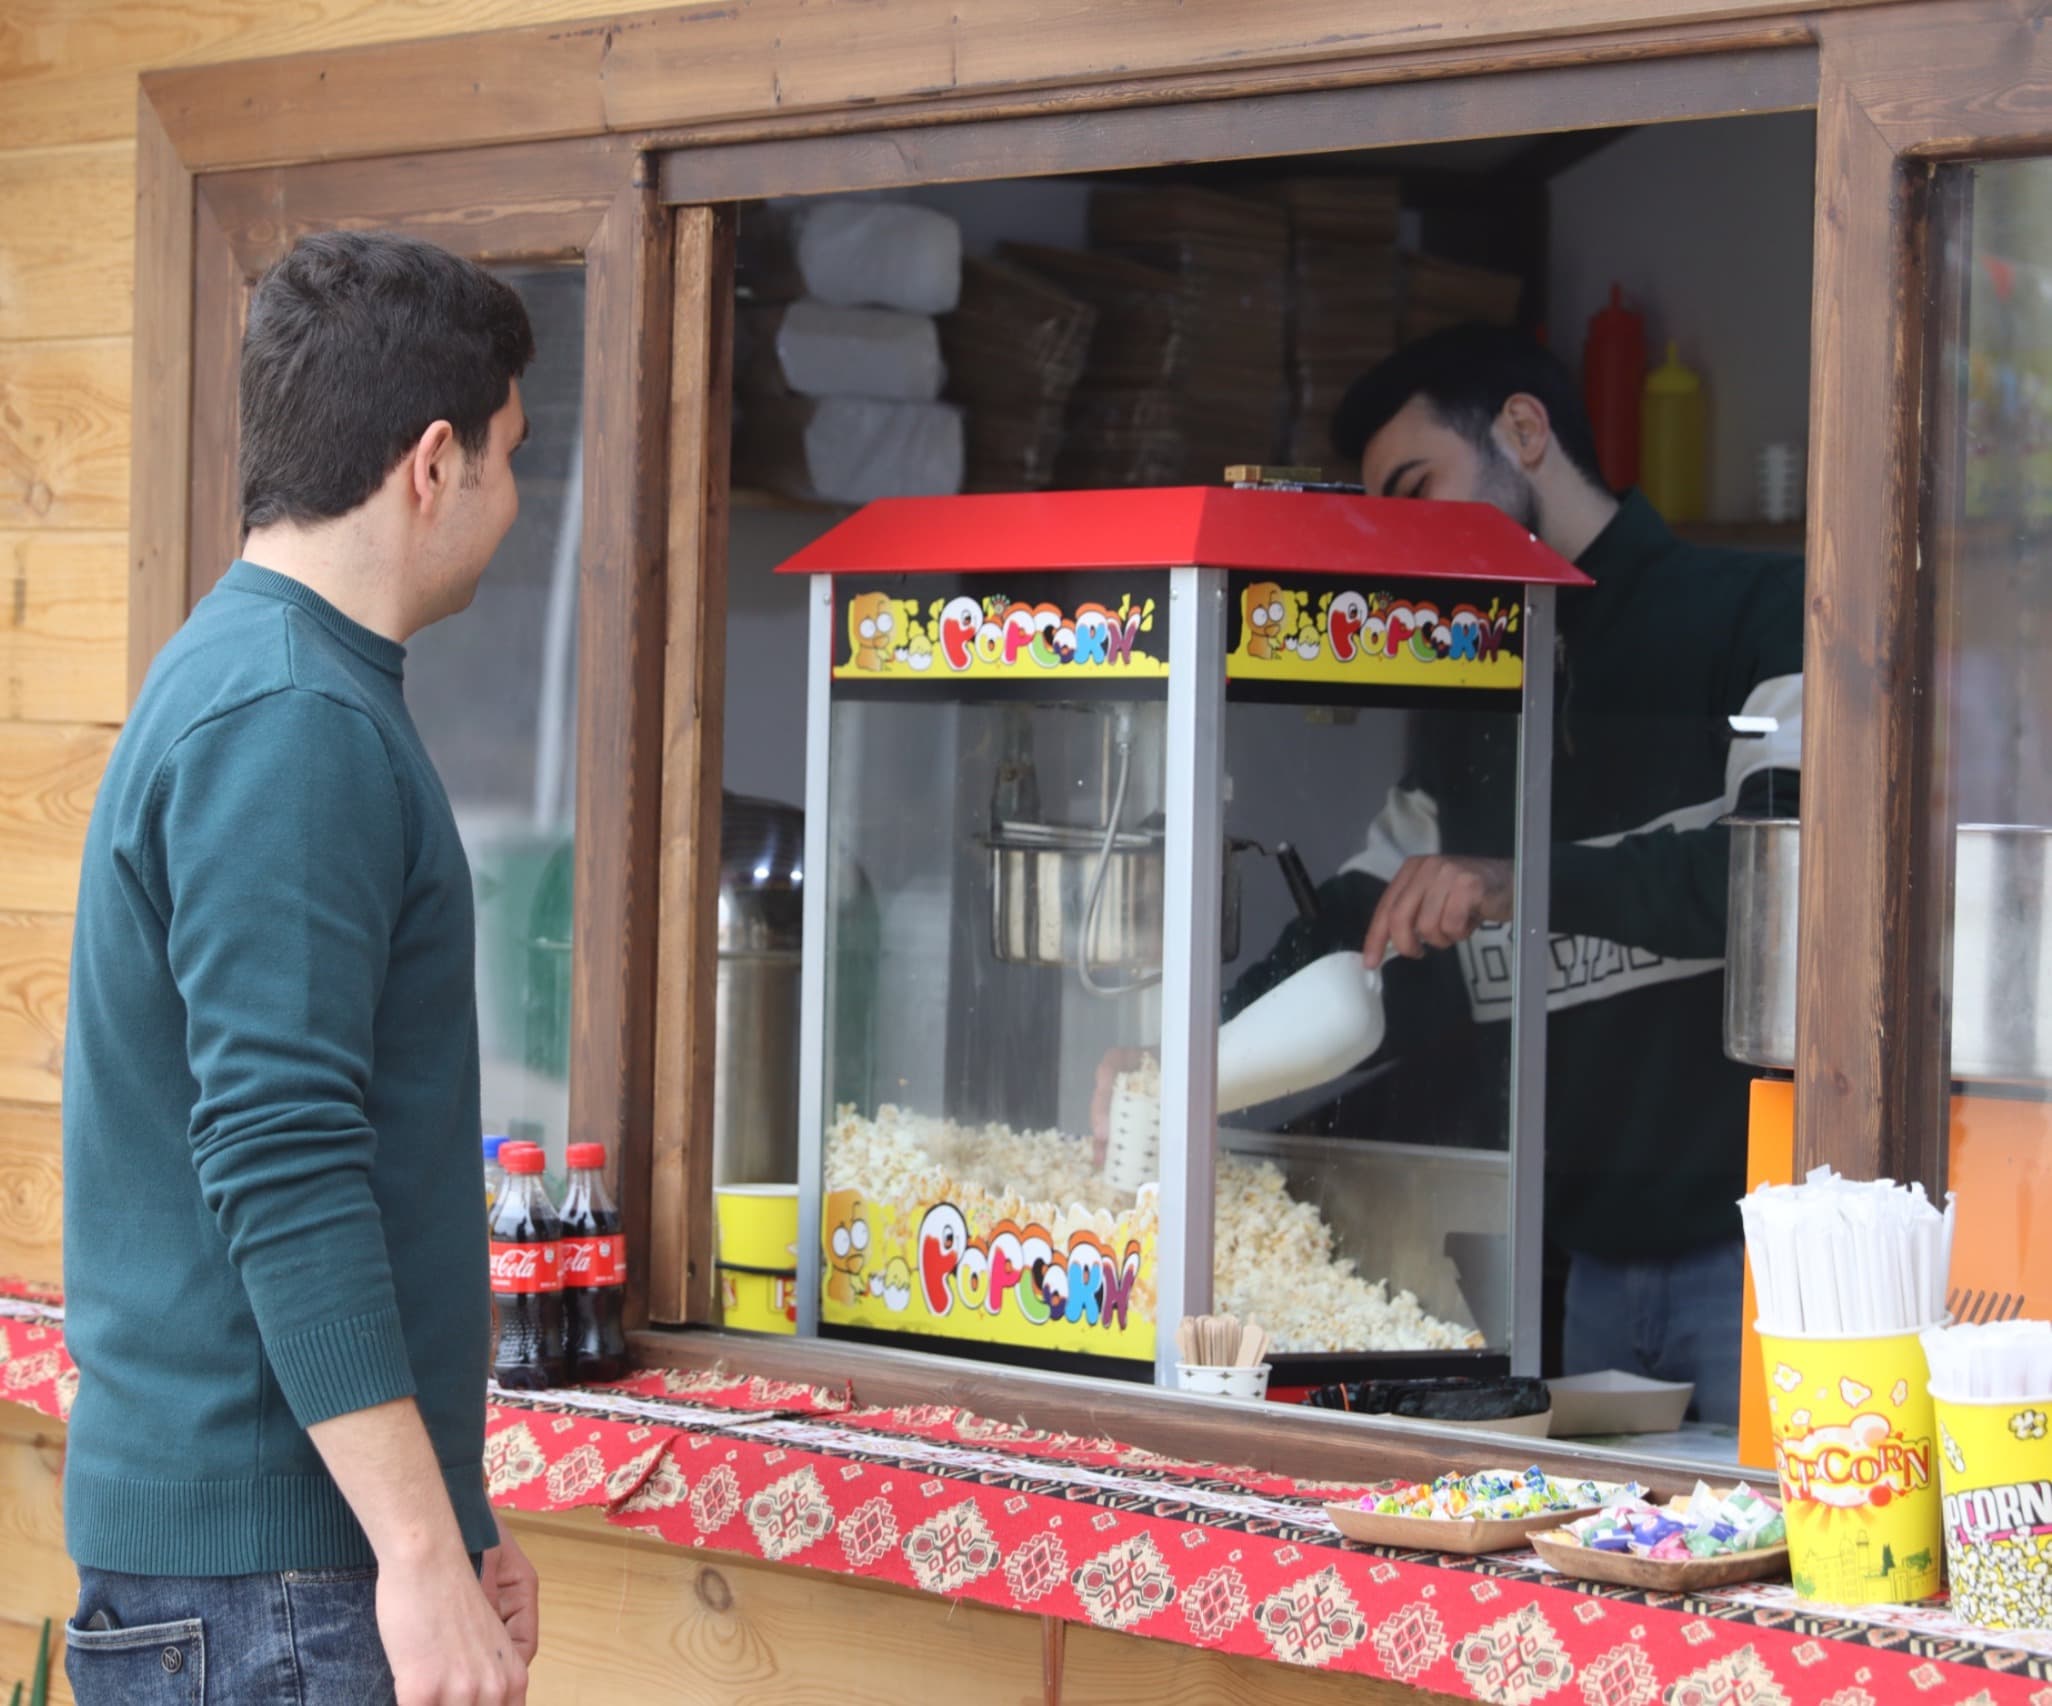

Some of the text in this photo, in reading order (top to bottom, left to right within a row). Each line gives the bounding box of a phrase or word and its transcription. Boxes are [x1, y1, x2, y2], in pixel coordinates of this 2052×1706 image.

[939, 596, 1141, 671] POPCORN
[1327, 591, 1508, 662] POPCORN
[919, 1202, 1140, 1330] POPCORN
